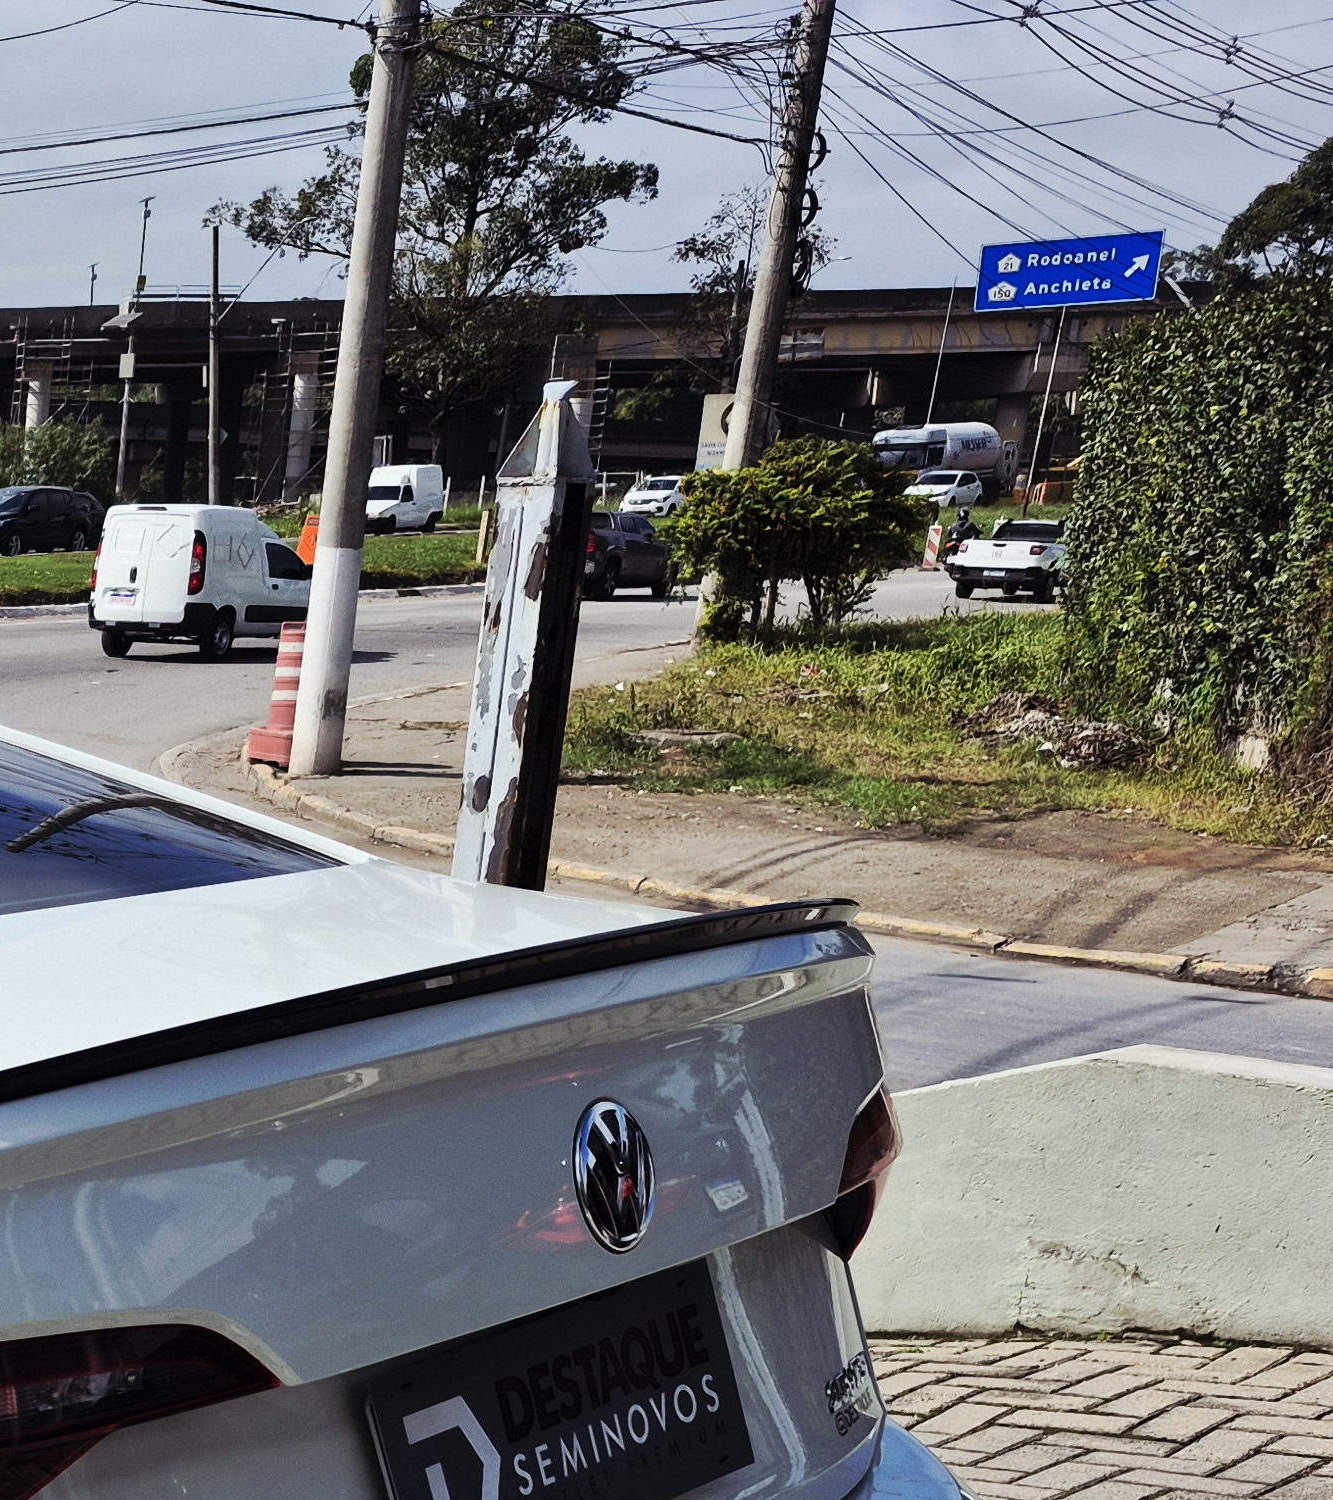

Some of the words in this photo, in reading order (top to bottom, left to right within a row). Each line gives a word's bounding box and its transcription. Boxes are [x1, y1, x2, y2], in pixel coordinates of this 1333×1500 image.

[993, 289, 1011, 299] 150
[1023, 277, 1112, 296] Anchieta
[1003, 262, 1013, 271] 21
[1027, 247, 1116, 268] Rodoanel
[494, 1303, 711, 1444] DESTAQUE
[513, 1374, 721, 1496] SEMINOVOS
[627, 1418, 729, 1477] PREMIUM
